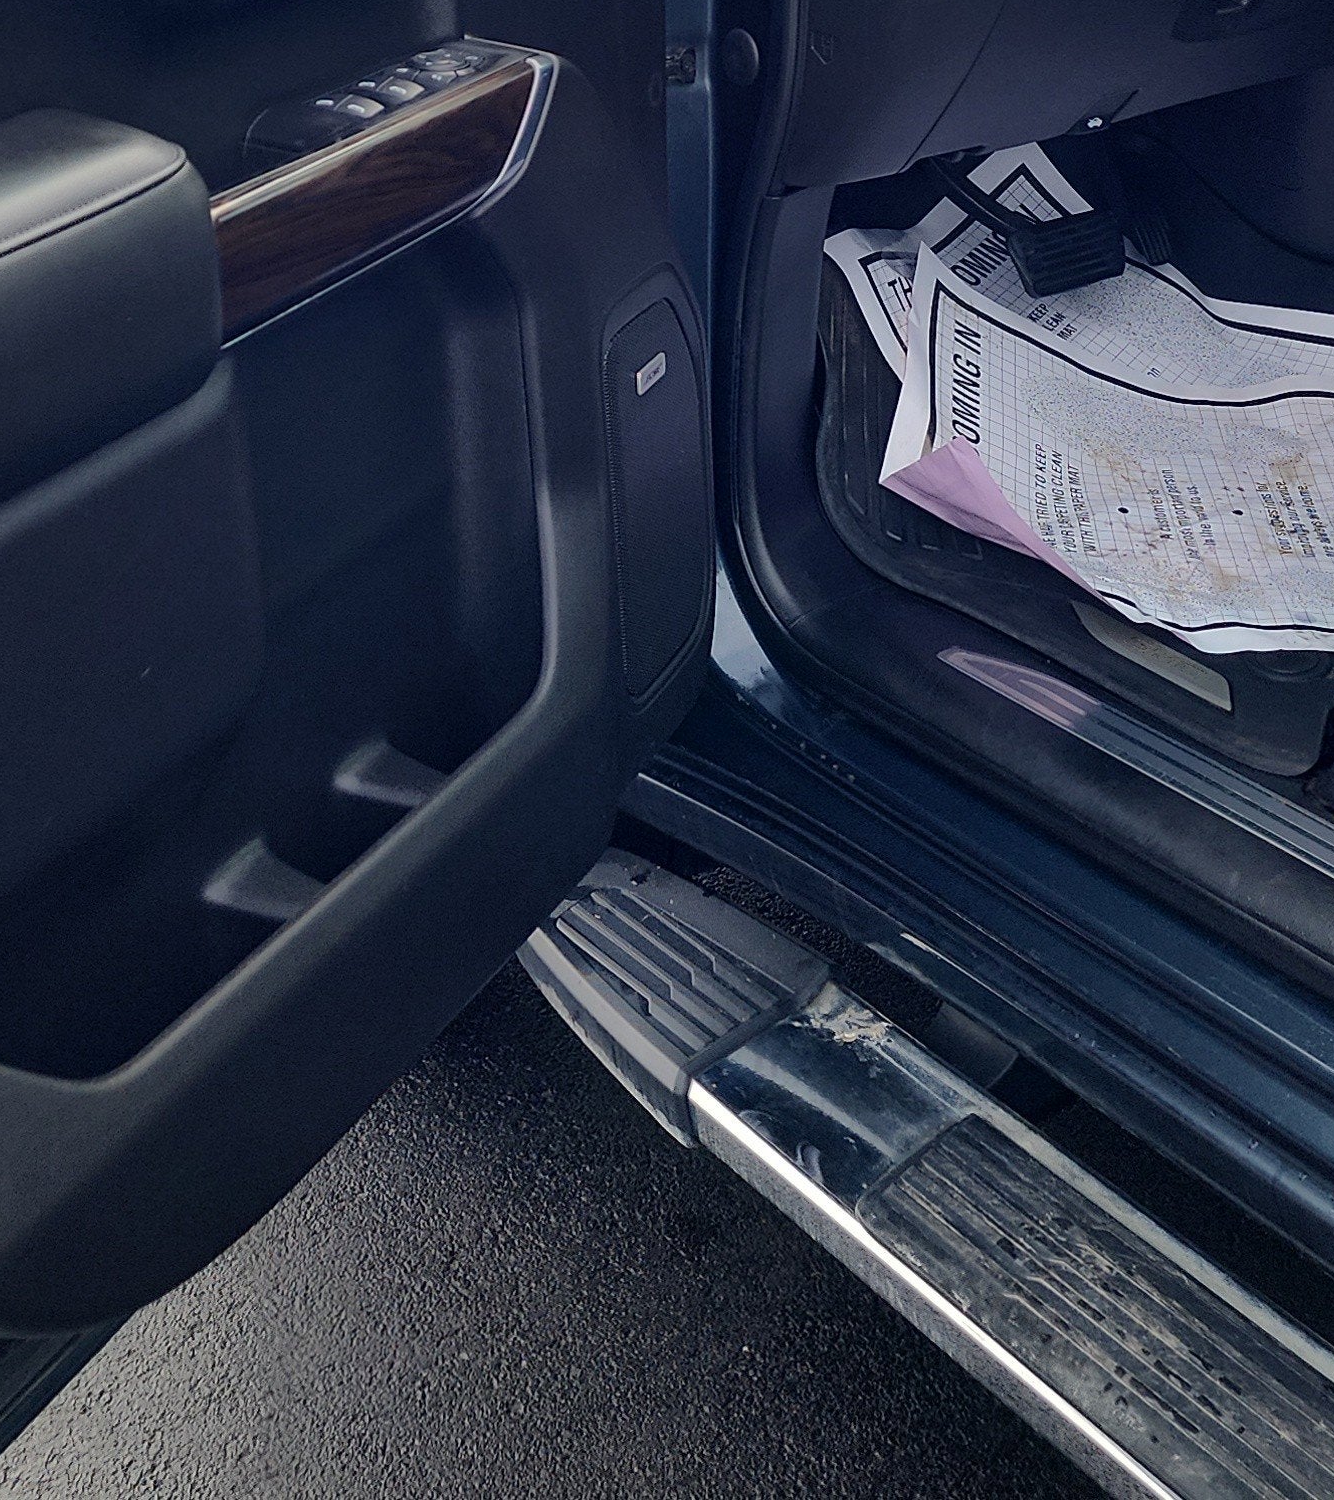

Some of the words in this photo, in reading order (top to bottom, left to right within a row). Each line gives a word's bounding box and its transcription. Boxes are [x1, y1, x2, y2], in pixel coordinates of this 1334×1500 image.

[1027, 304, 1049, 323] KEEP
[954, 320, 981, 355] IN
[1057, 324, 1077, 340] MAT
[952, 354, 981, 456] OMING
[1035, 443, 1046, 473] KEEP
[1051, 450, 1063, 486] CLEAN
[1035, 475, 1046, 489] TO
[1067, 464, 1080, 485] MAT
[1161, 469, 1181, 494] person
[1035, 492, 1050, 520] TRIED
[1070, 488, 1086, 511] PAPER
[1151, 495, 1171, 531] customer
[1061, 530, 1077, 553] YOUR
[1081, 530, 1096, 552] WITH
[1179, 528, 1197, 547] most
[1199, 524, 1213, 537] the
[1278, 538, 1293, 556] Your
